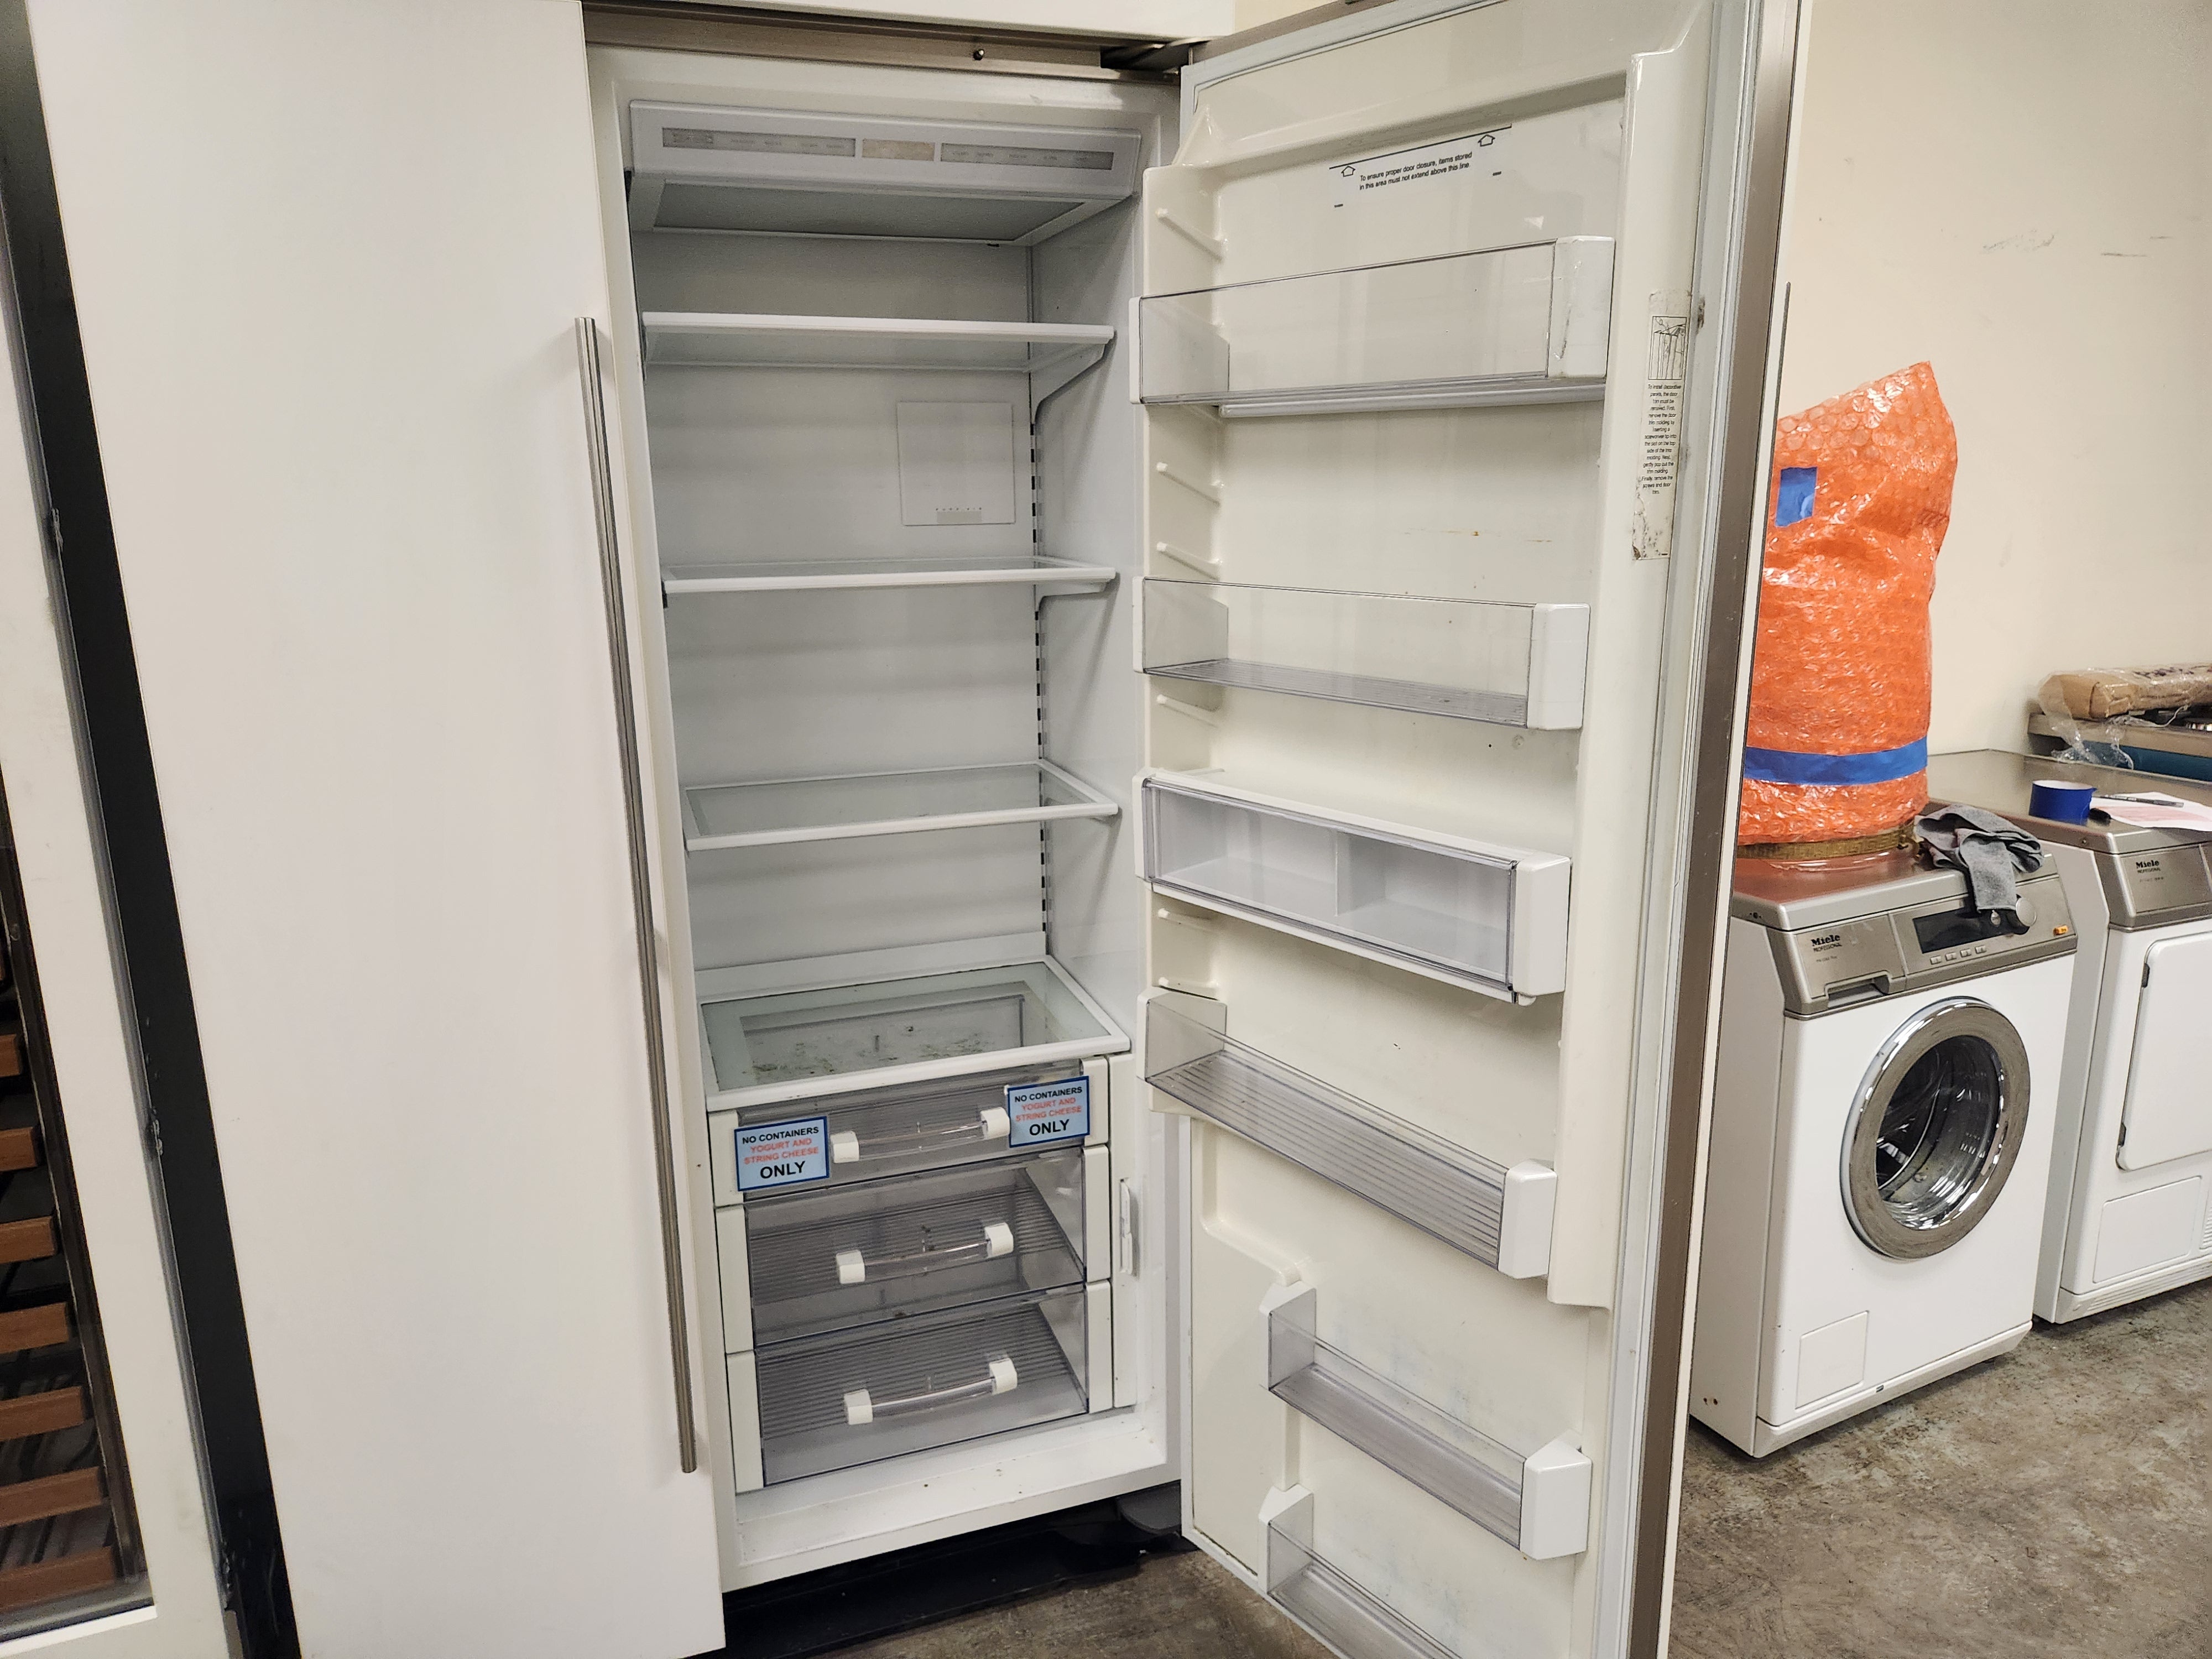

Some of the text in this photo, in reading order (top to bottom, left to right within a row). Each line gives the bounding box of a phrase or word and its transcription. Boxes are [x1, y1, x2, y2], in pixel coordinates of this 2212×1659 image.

[1385, 168, 1402, 178] proper
[1455, 152, 1472, 161] stored
[1411, 170, 1429, 180] extend
[1430, 167, 1447, 175] above
[2136, 859, 2159, 869] Miele
[1811, 935, 1841, 946] Miele
[1029, 1087, 1082, 1100] CONTAINERS
[1021, 1097, 1076, 1110] YOGURT AND
[1015, 1105, 1082, 1122] STRING CHEESE
[742, 1126, 819, 1144] NO CONTAINERS
[1029, 1119, 1070, 1136] ONLY
[750, 1138, 812, 1153] YOGURT AND
[744, 1146, 819, 1165] STRING CHEESE
[760, 1161, 805, 1179] ONLY
